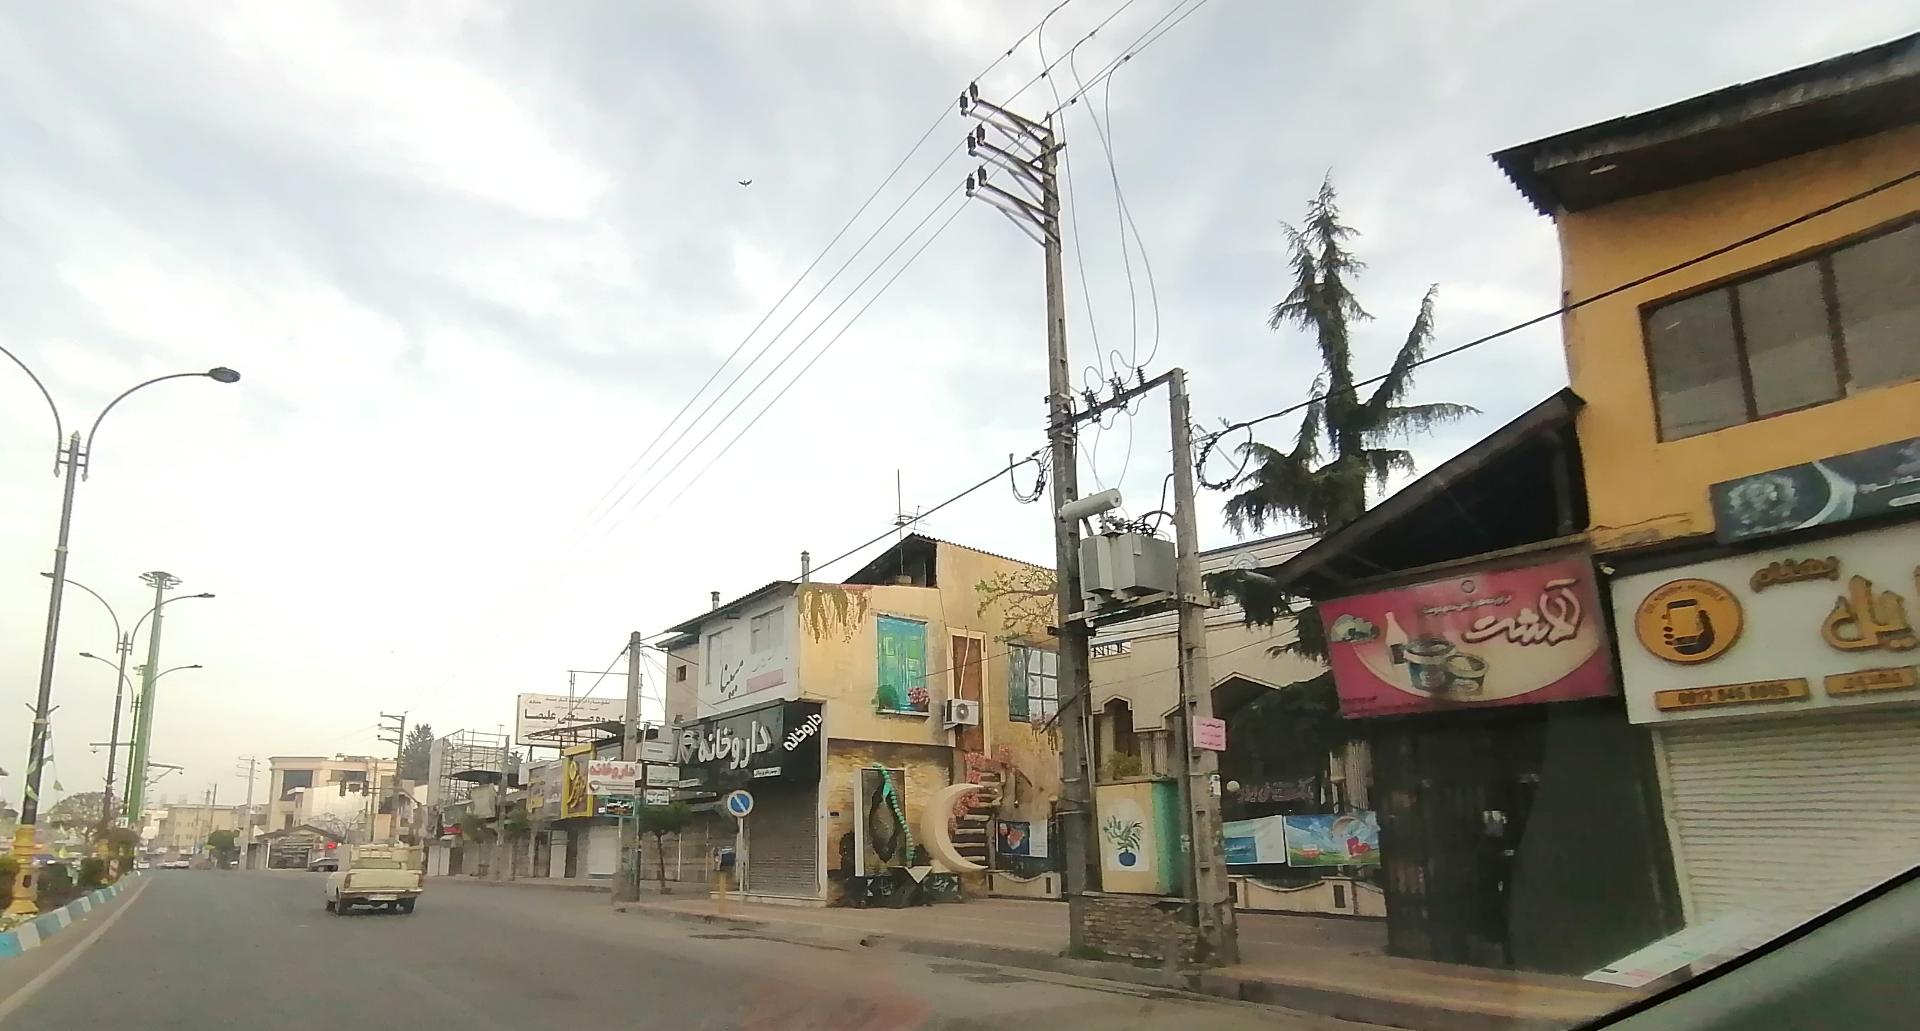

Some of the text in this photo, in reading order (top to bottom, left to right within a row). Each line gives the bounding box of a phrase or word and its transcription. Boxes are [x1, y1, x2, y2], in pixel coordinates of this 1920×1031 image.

[698, 720, 772, 770] داروخانه
[783, 713, 822, 751] داروخانه
[590, 763, 636, 780] داروخانه
